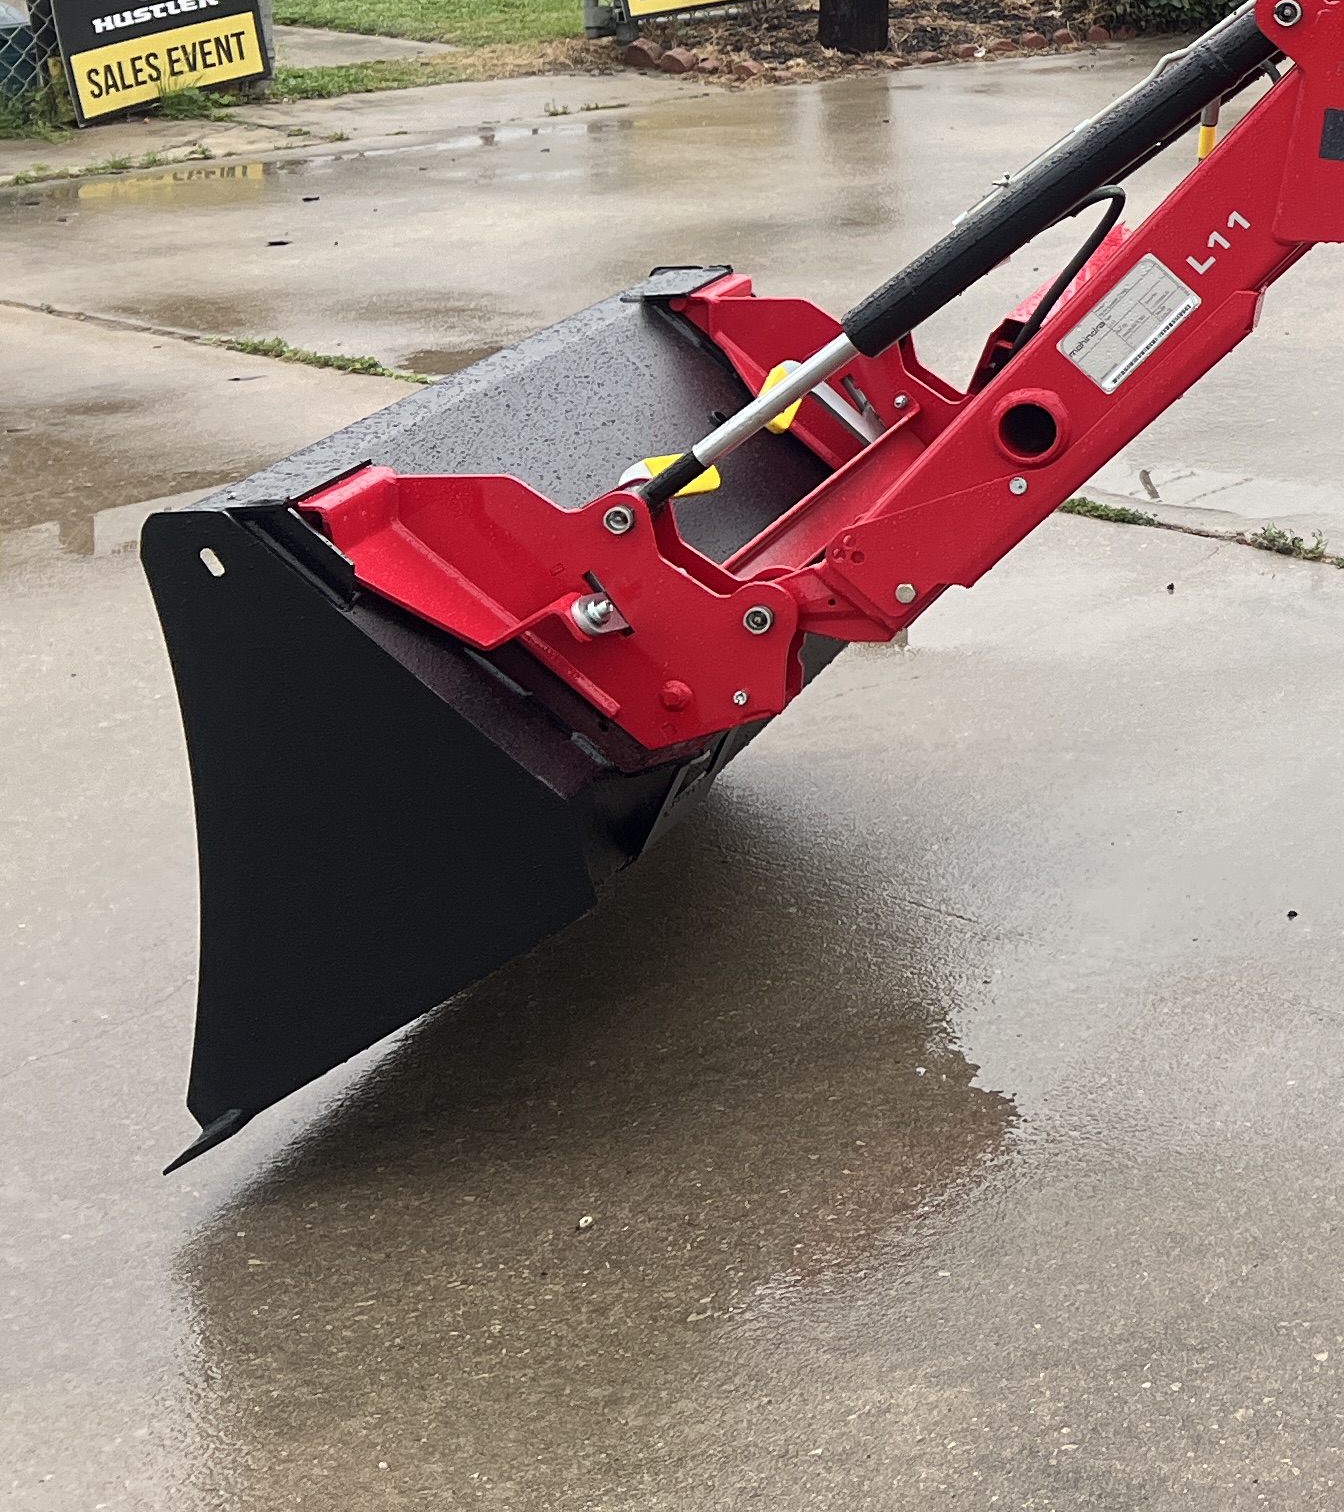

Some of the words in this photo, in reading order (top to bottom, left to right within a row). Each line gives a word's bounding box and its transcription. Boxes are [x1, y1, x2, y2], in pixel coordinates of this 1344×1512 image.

[86, 52, 161, 99] SALES
[166, 31, 246, 77] EVENT
[1186, 210, 1251, 274] L11
[1068, 321, 1106, 358] mahindra
